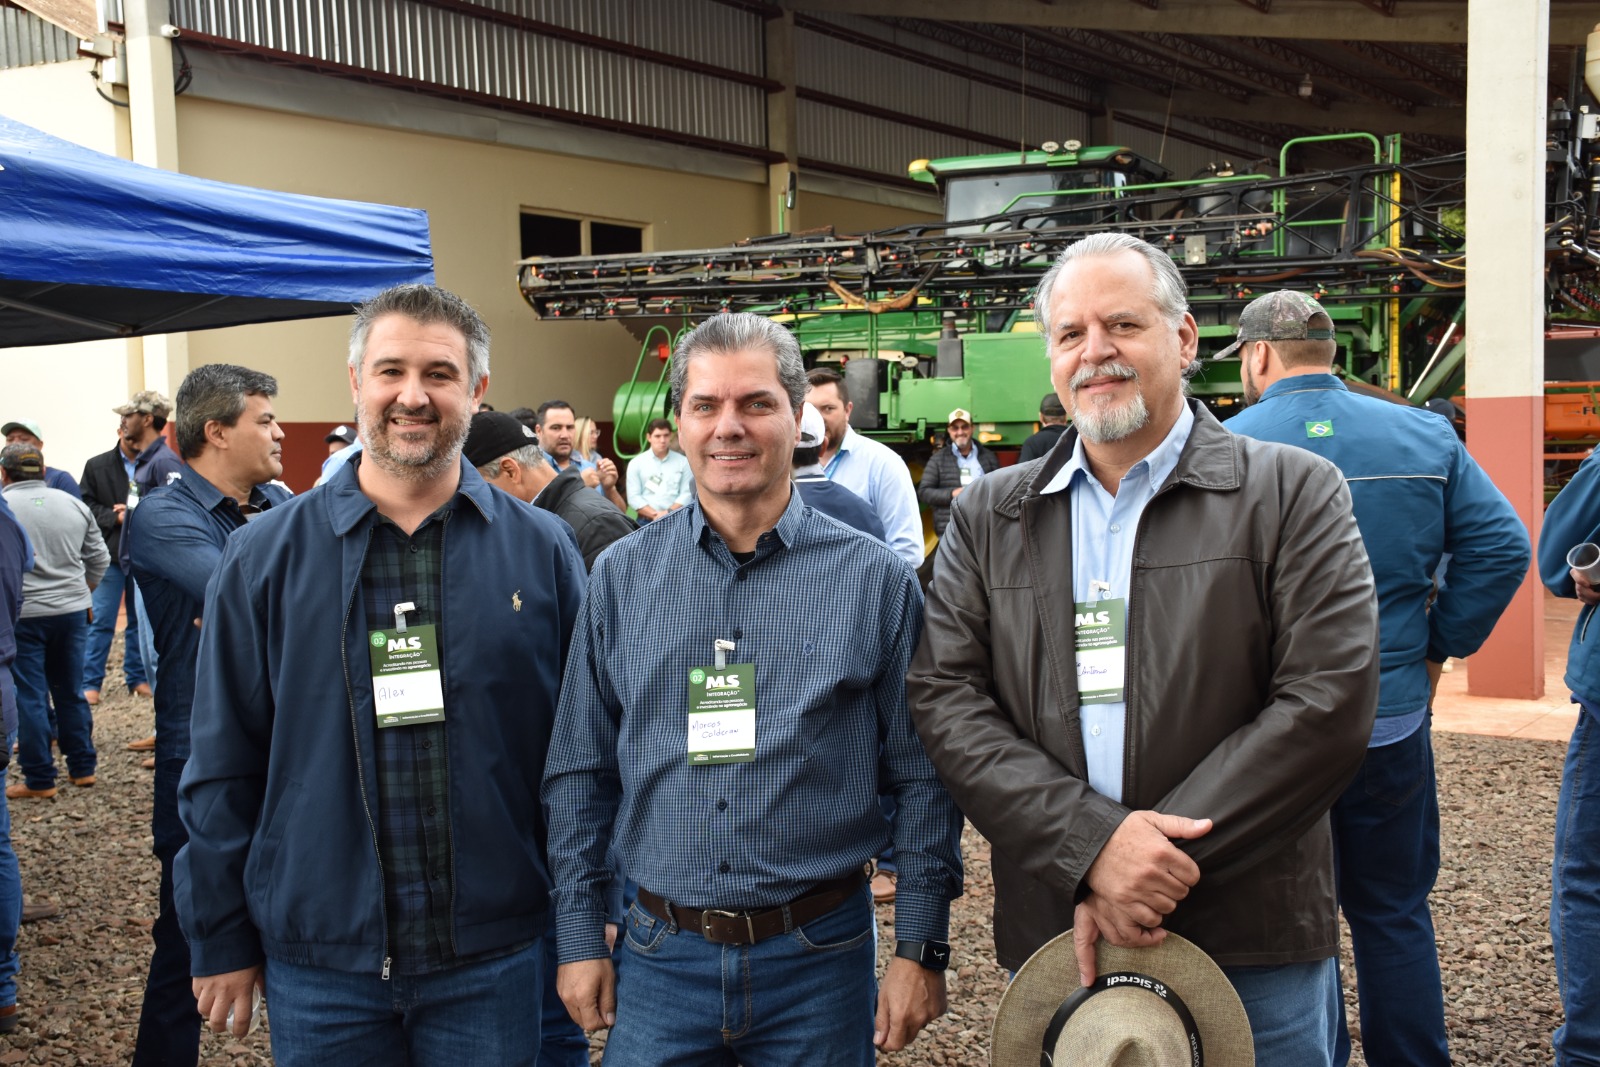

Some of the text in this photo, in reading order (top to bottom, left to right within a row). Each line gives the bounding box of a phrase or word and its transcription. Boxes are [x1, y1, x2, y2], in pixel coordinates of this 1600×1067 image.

[1075, 611, 1110, 627] MS
[388, 636, 422, 652] MS
[389, 652, 421, 660] INTEGRAÇÃO
[706, 675, 740, 689] MS
[379, 687, 405, 701] Alex
[1107, 976, 1152, 989] Sicredi
